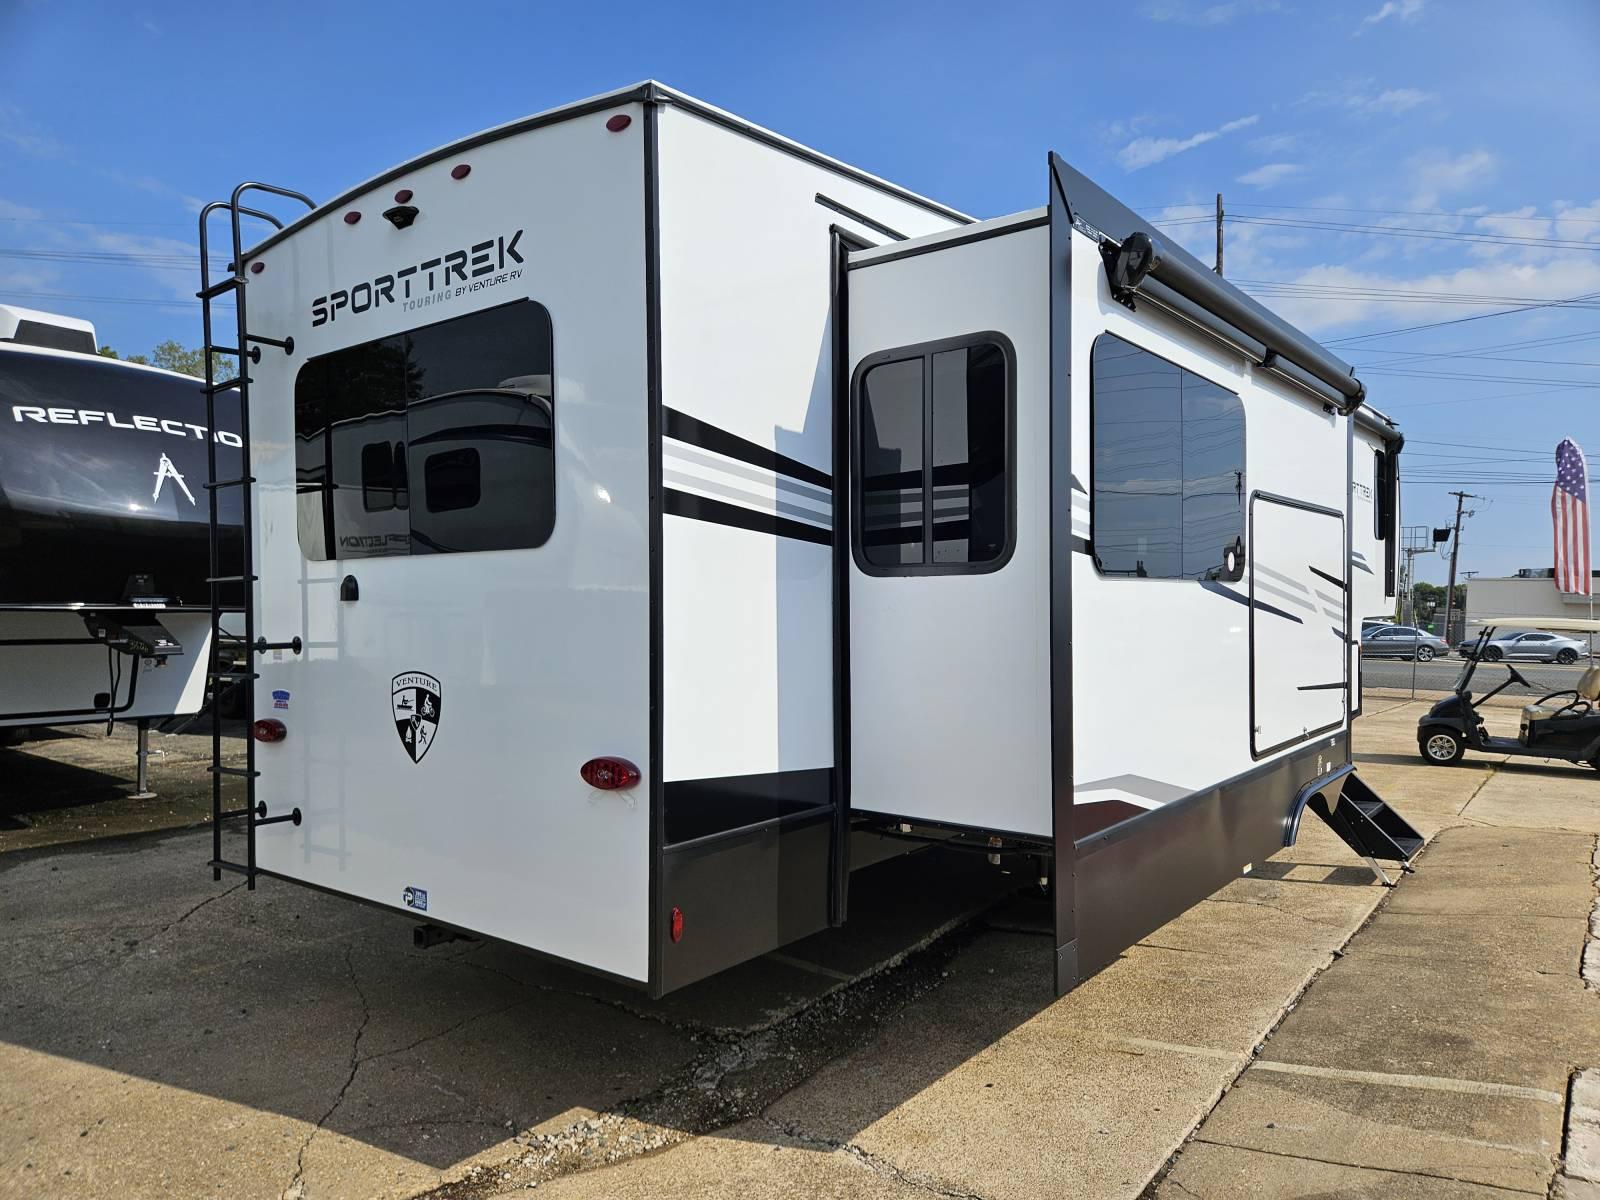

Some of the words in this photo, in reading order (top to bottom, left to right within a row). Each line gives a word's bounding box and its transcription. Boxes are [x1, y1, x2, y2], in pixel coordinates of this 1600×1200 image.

[312, 229, 524, 328] SPORTTREK
[402, 290, 452, 313] TOURING
[455, 286, 467, 297] BY
[468, 272, 508, 292] VENTURE
[509, 269, 523, 280] RV
[396, 676, 438, 692] VENTURE
